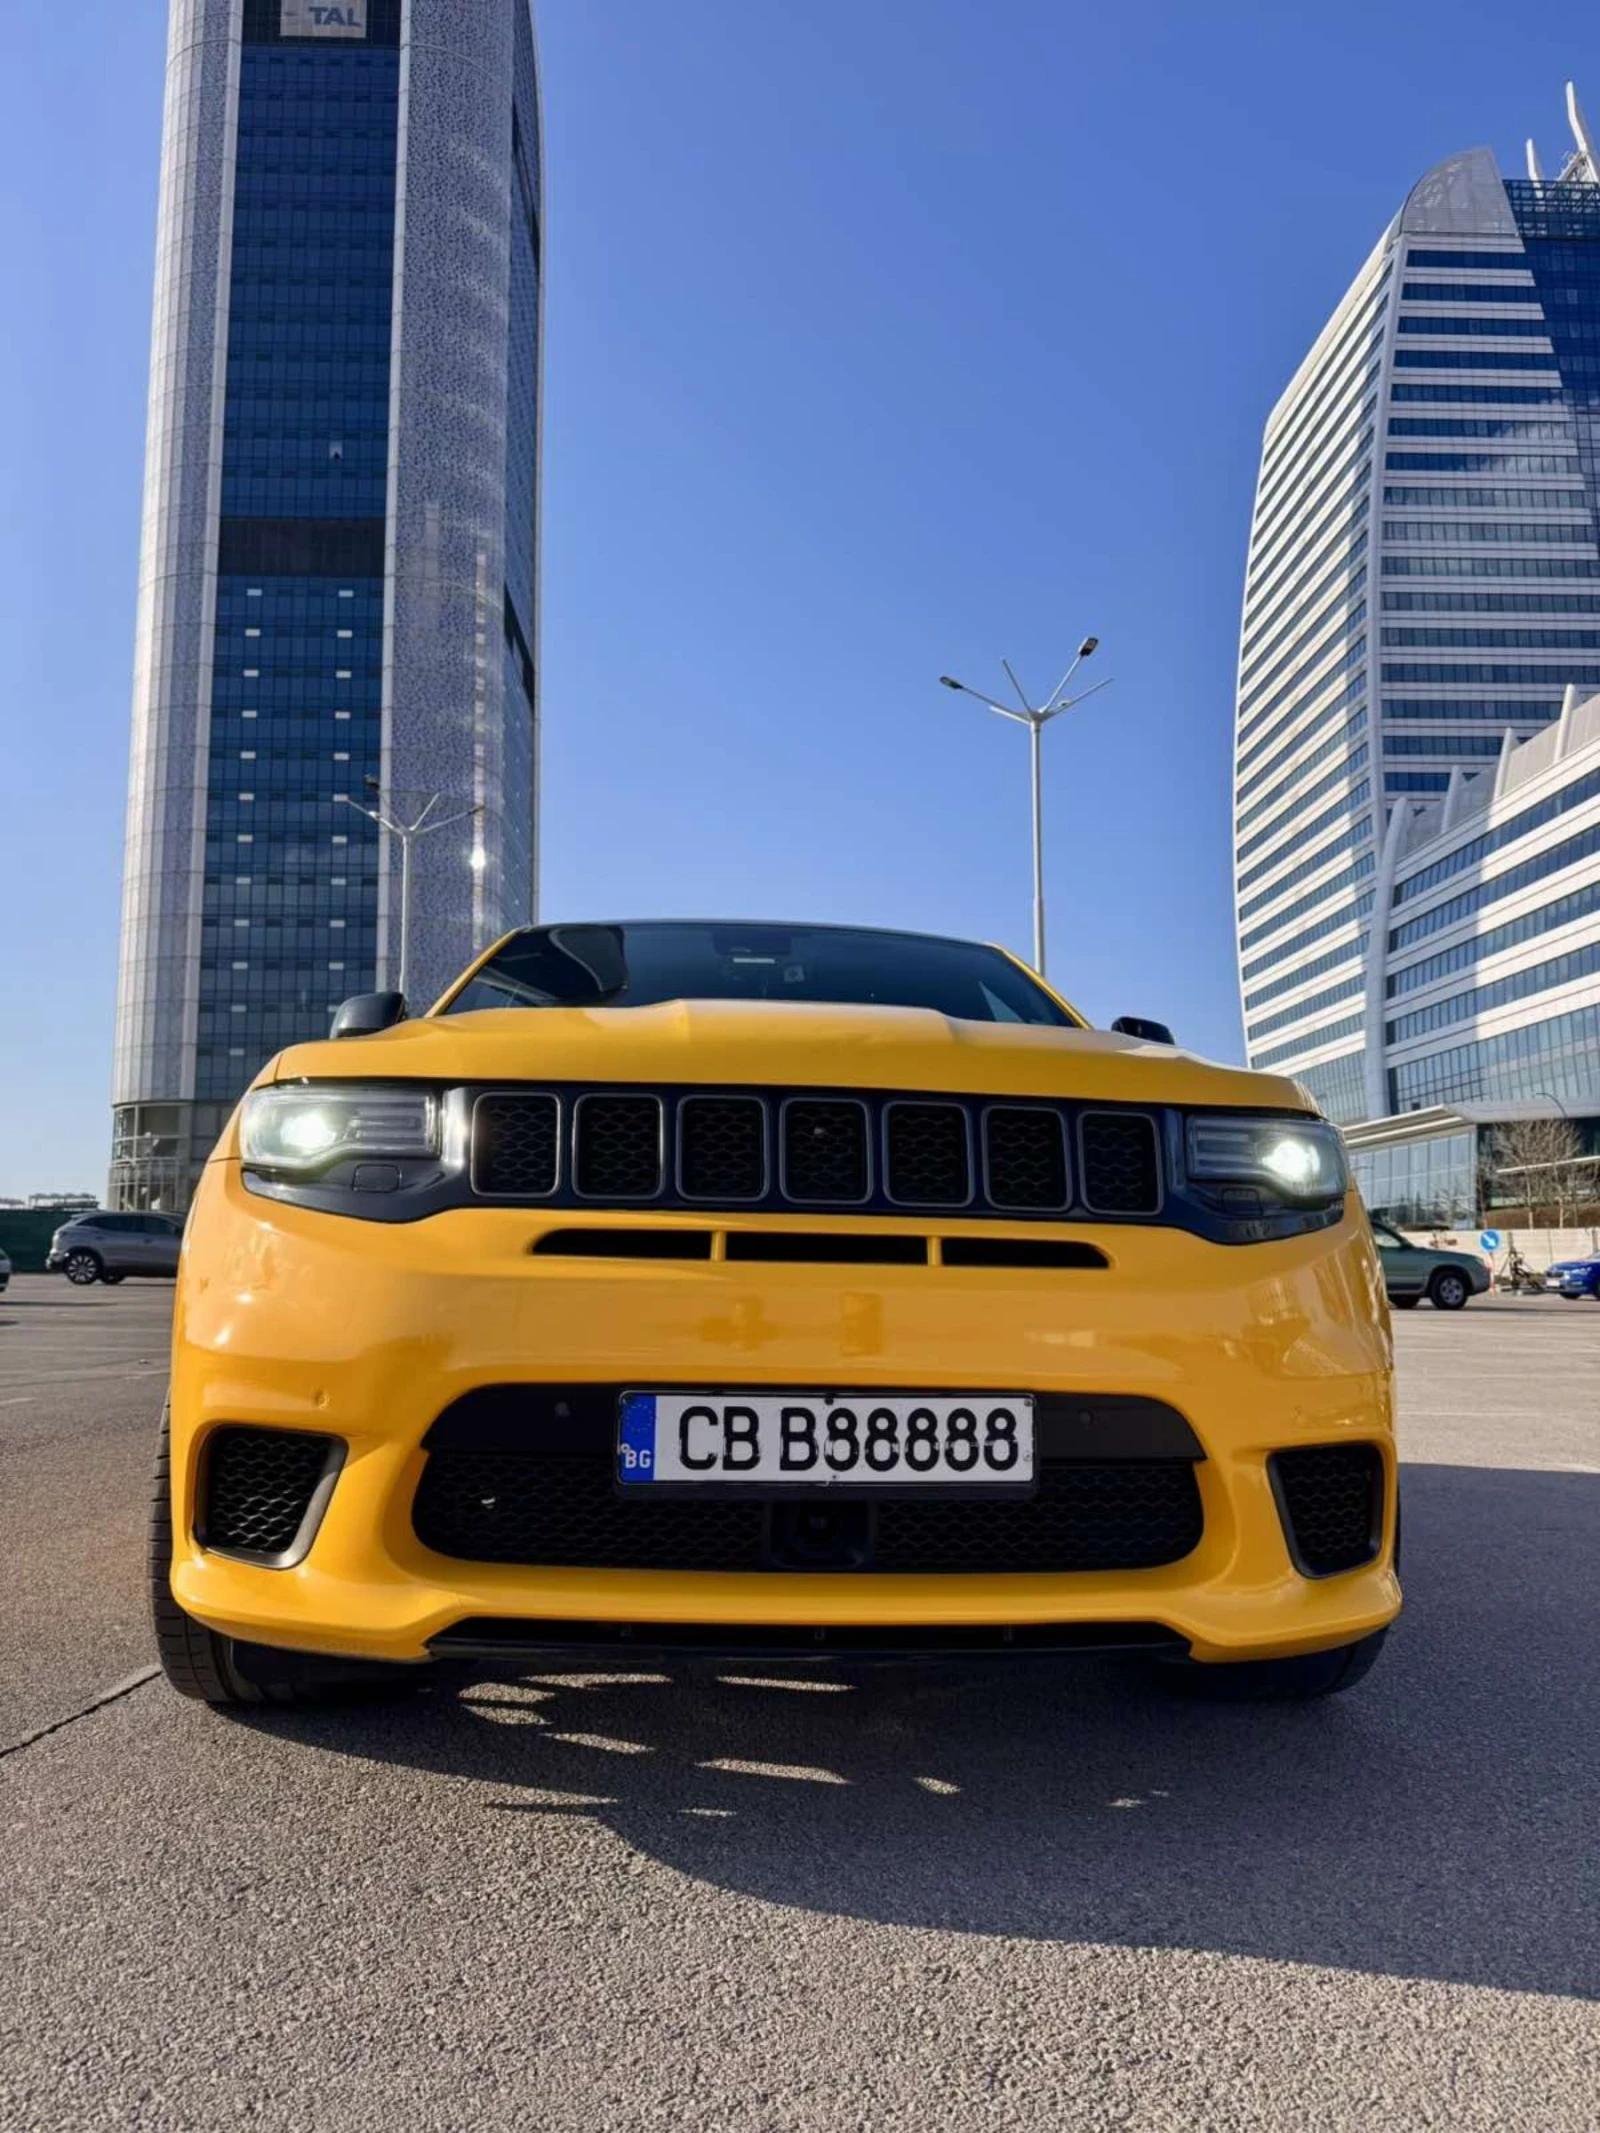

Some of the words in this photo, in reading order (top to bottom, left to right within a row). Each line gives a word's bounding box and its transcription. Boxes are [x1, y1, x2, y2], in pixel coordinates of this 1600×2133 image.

[625, 1450, 651, 1469] BG
[679, 1405, 761, 1471] CB
[780, 1406, 1019, 1472] B88888
